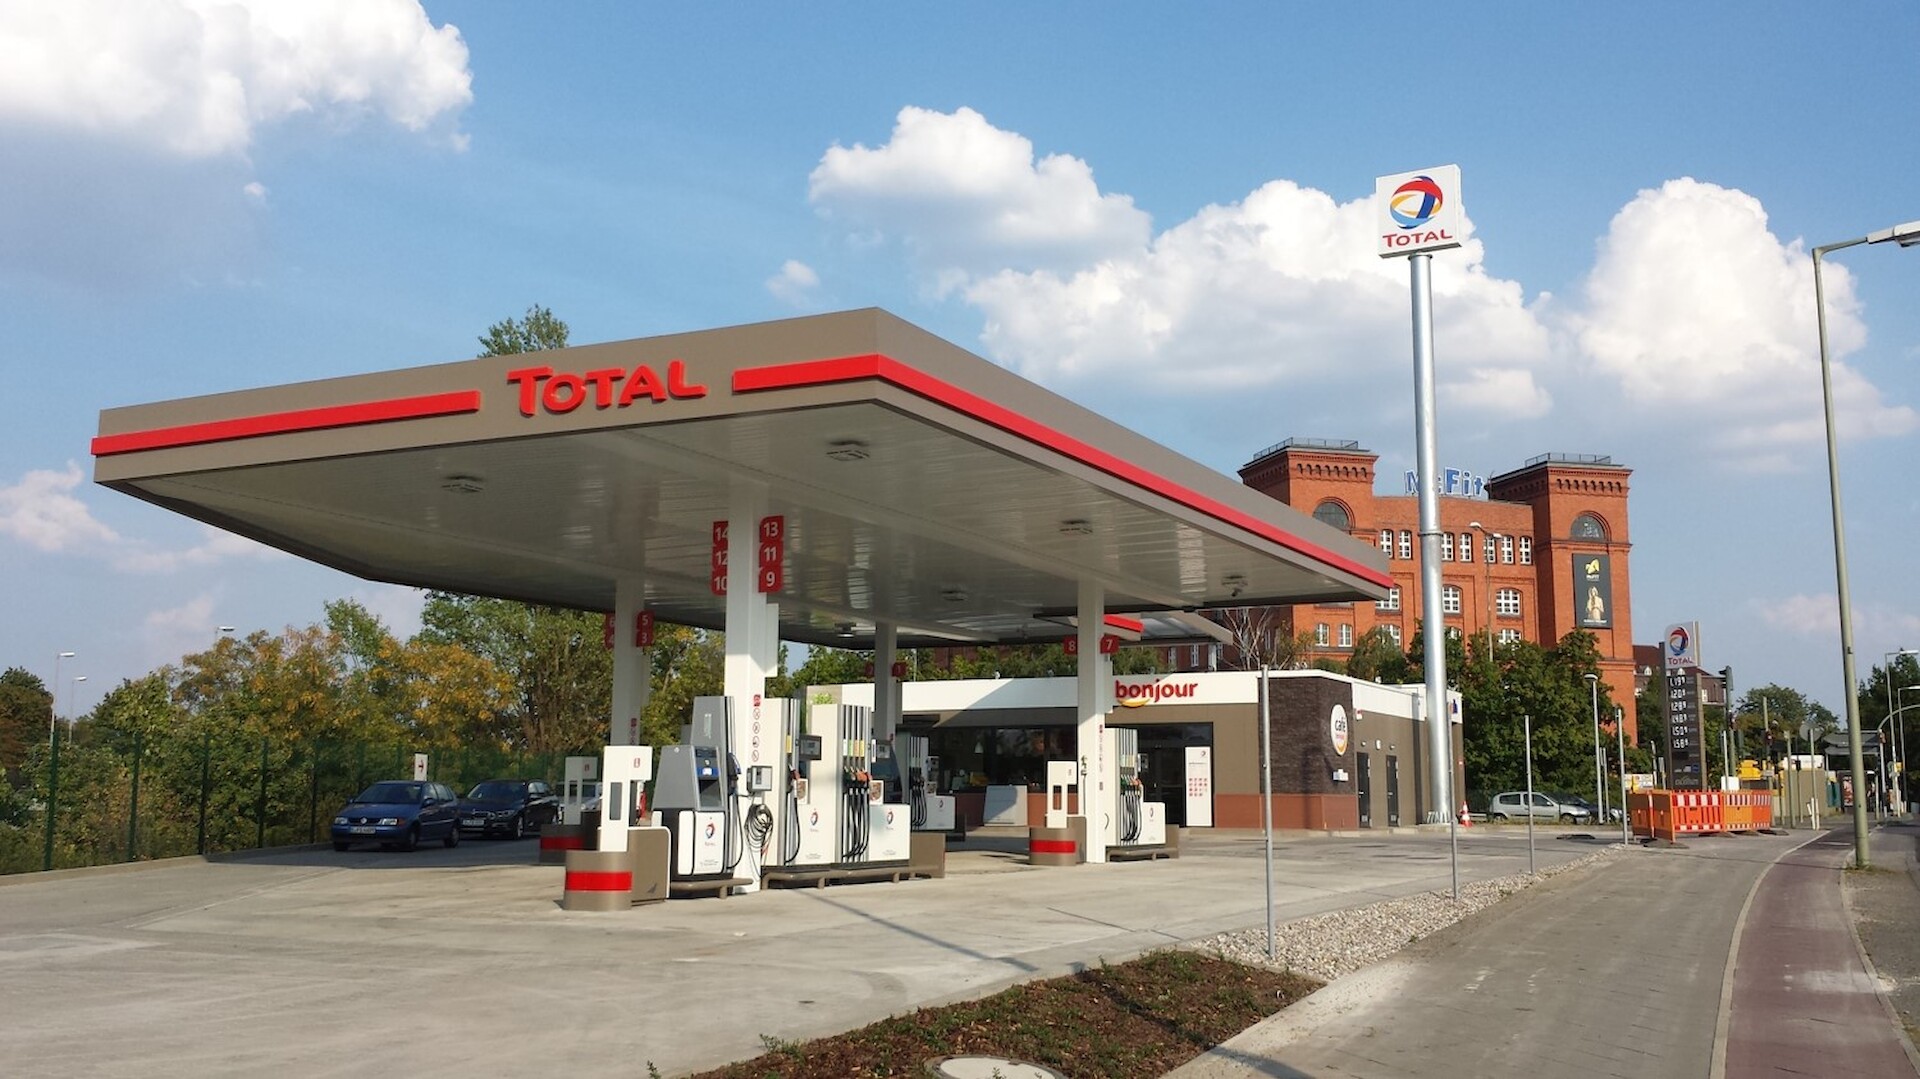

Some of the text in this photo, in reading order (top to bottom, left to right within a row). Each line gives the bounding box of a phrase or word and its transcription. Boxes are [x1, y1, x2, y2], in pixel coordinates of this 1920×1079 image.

[1382, 229, 1453, 247] TOTAL
[507, 359, 708, 416] TOTAL
[763, 521, 779, 537] 13
[764, 546, 777, 562] 11
[766, 571, 776, 587] 9
[642, 614, 649, 626] 5
[641, 632, 648, 644] 3
[1069, 640, 1076, 651] 8
[1106, 639, 1113, 650] 7
[1668, 656, 1694, 665] TOTAL
[1115, 679, 1199, 703] bonjour
